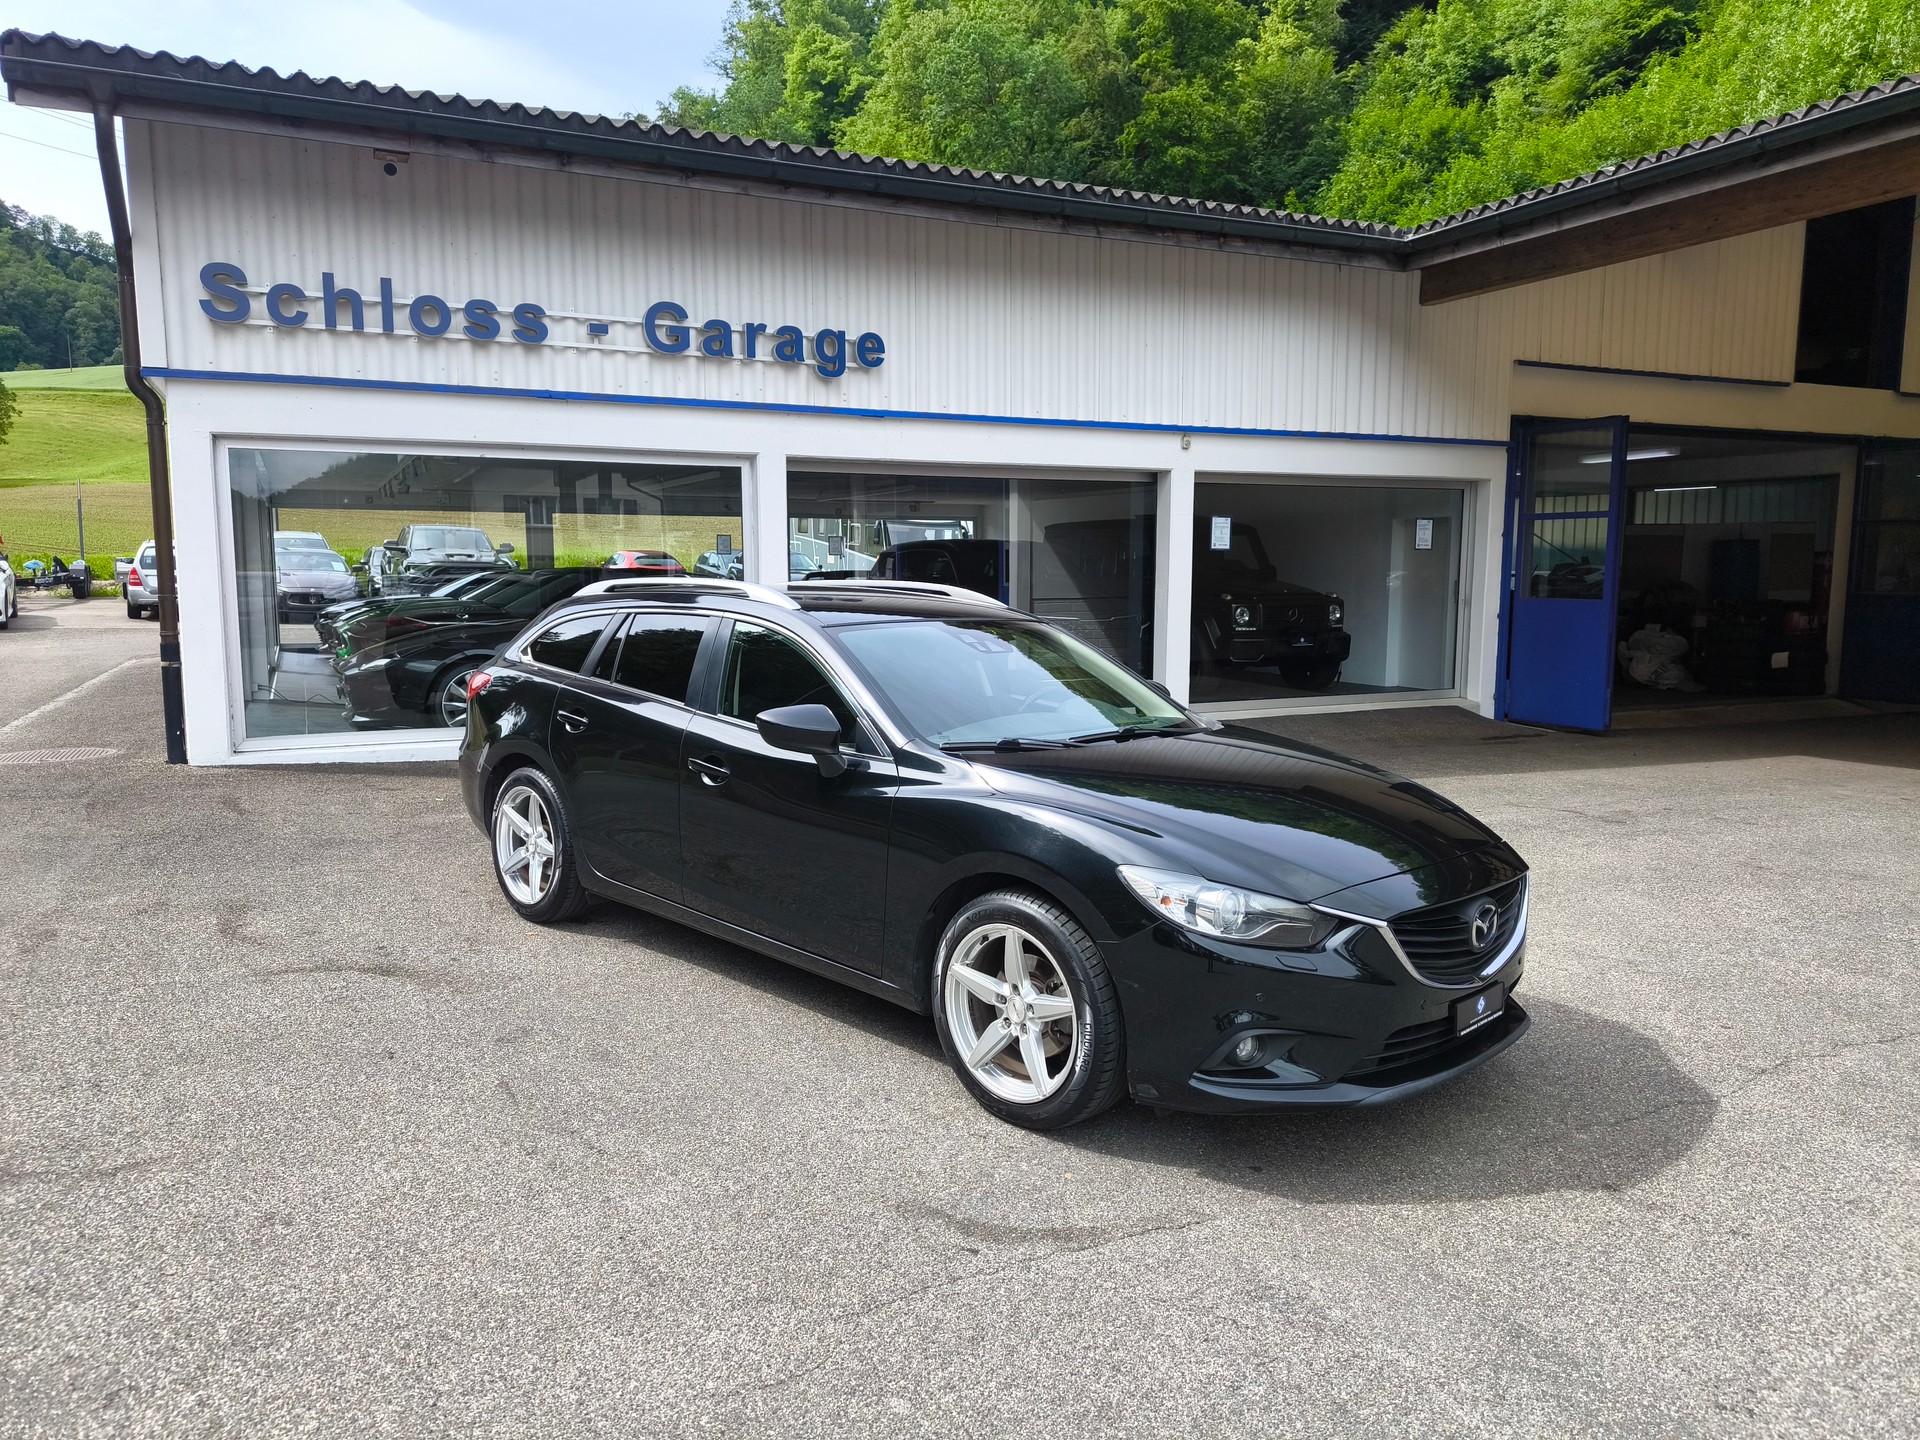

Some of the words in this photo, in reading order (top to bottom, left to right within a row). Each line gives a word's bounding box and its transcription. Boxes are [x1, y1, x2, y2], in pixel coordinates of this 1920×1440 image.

[199, 262, 548, 346] Schloss
[643, 301, 886, 379] Garage
[1079, 1022, 1093, 1073] GIUGIARO
